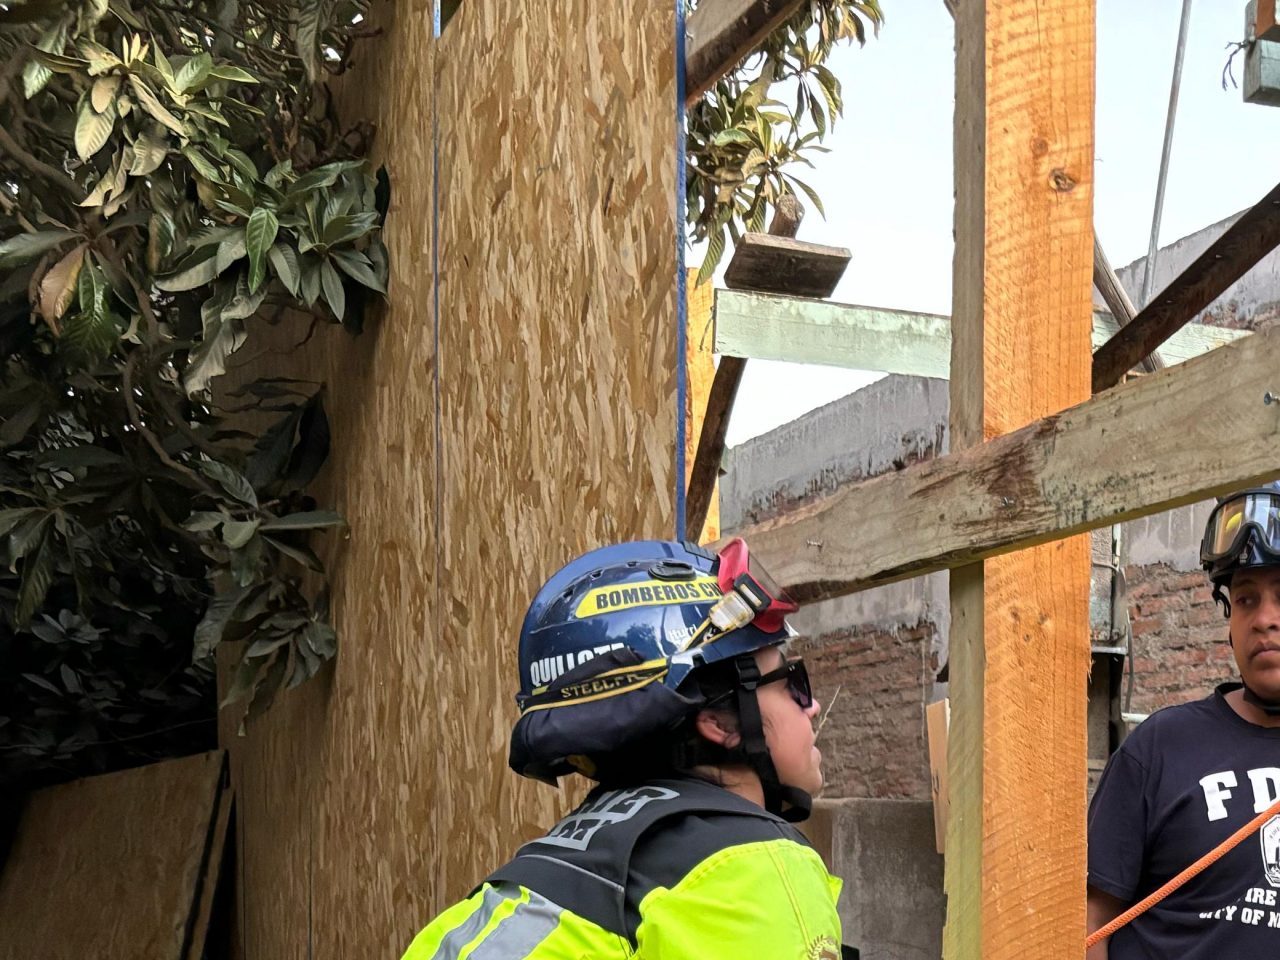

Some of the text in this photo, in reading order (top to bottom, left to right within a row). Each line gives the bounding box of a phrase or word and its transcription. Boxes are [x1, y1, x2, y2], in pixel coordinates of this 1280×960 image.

[596, 583, 701, 610] BOMBEROS
[530, 642, 625, 688] QUILLOT
[1243, 887, 1278, 907] IRE
[1241, 907, 1265, 926] OF
